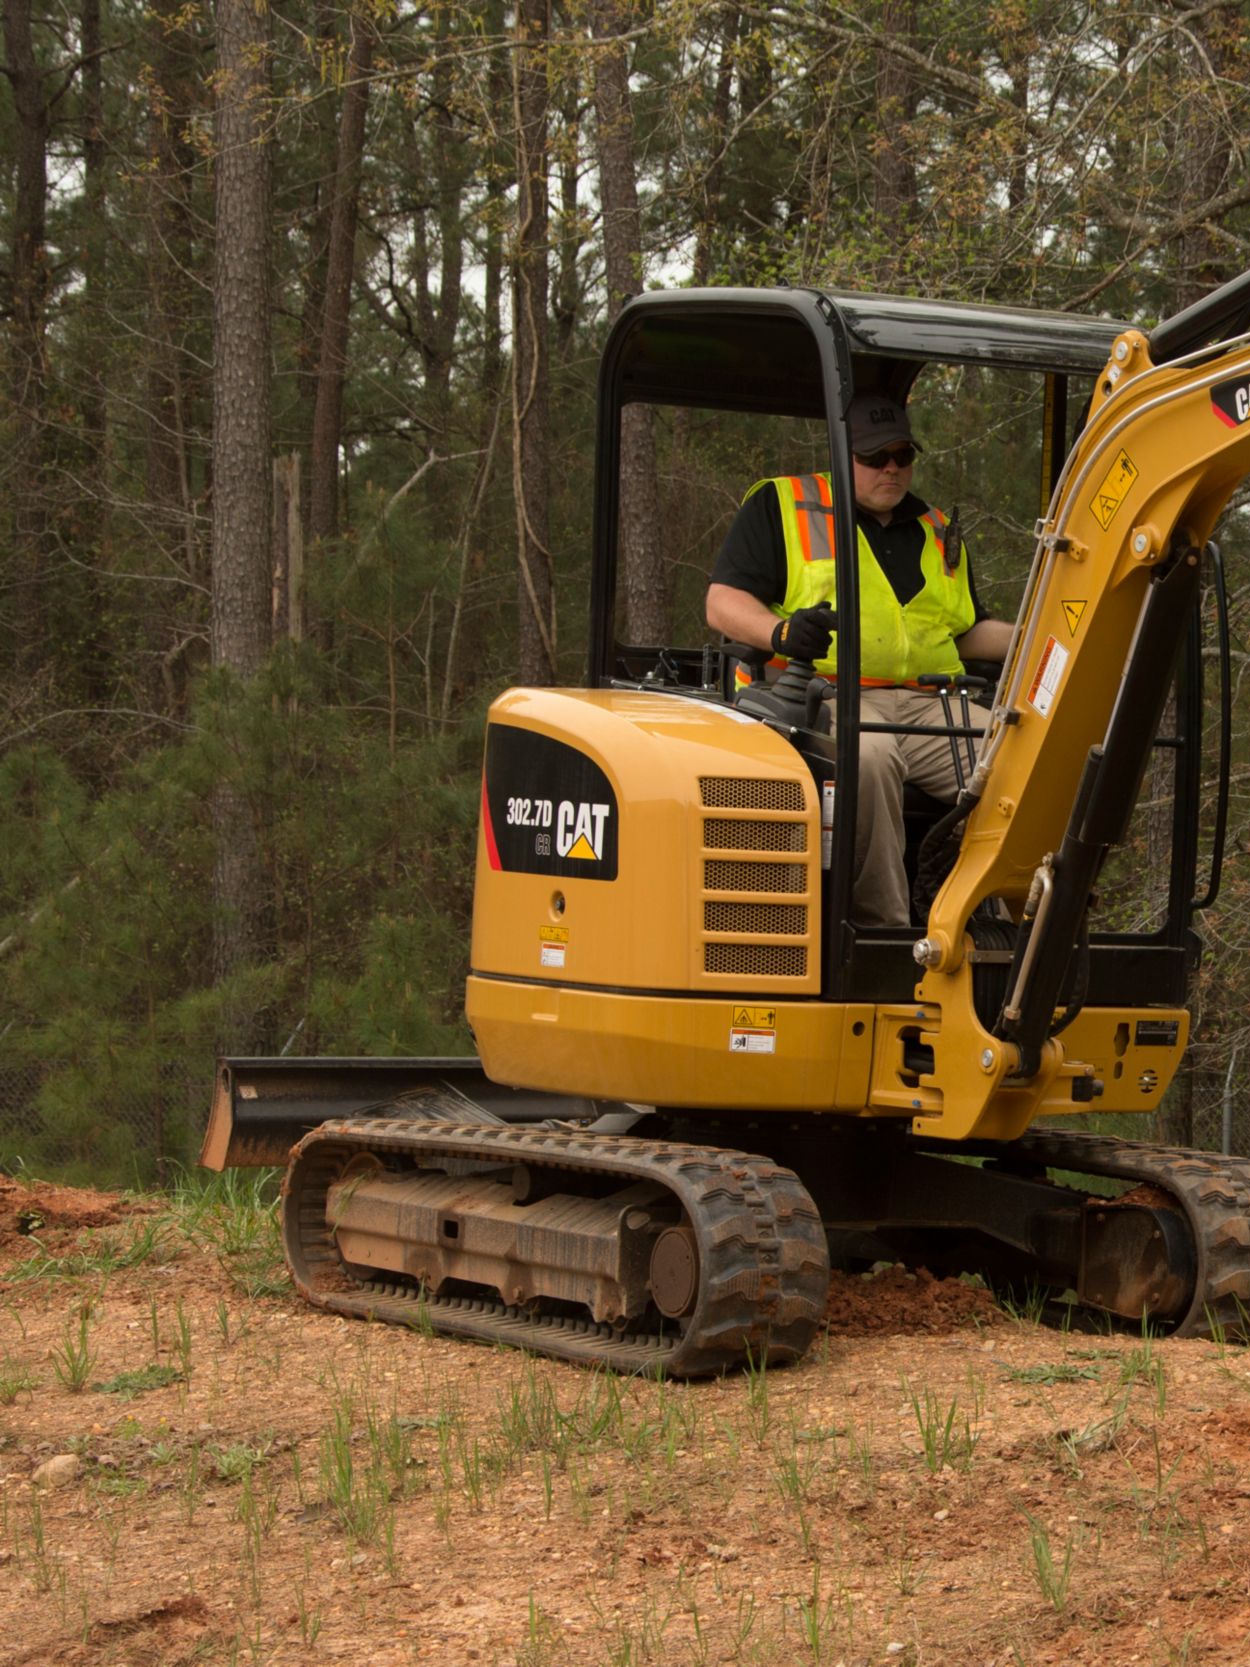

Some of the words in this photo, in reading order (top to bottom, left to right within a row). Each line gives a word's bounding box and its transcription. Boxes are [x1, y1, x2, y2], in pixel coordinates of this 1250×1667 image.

[869, 407, 896, 424] CAT
[506, 797, 552, 828] 302.7D
[556, 800, 610, 861] CAT
[535, 833, 551, 856] CR
